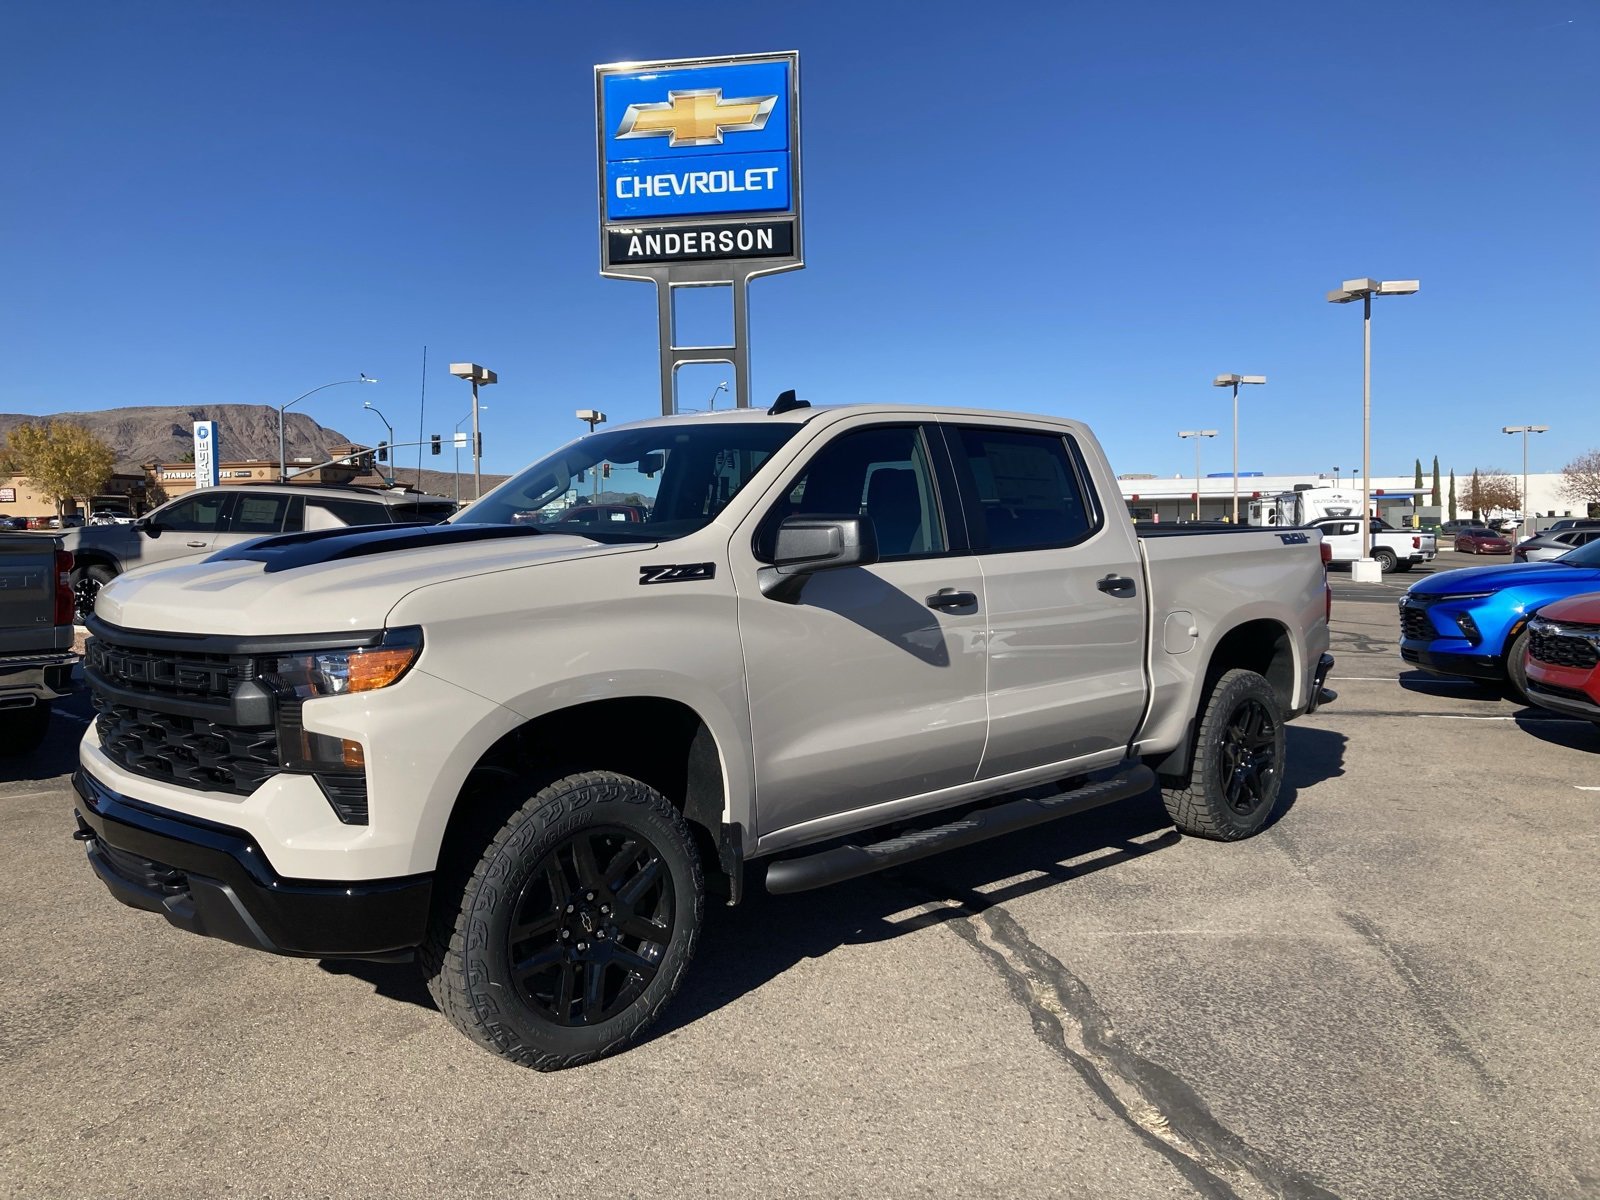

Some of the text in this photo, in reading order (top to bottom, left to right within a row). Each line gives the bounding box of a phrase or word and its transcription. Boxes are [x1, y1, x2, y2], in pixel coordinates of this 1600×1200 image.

[616, 167, 779, 199] CHEVROLET
[627, 228, 773, 256] ANDERSON
[163, 471, 196, 480] STARBUC
